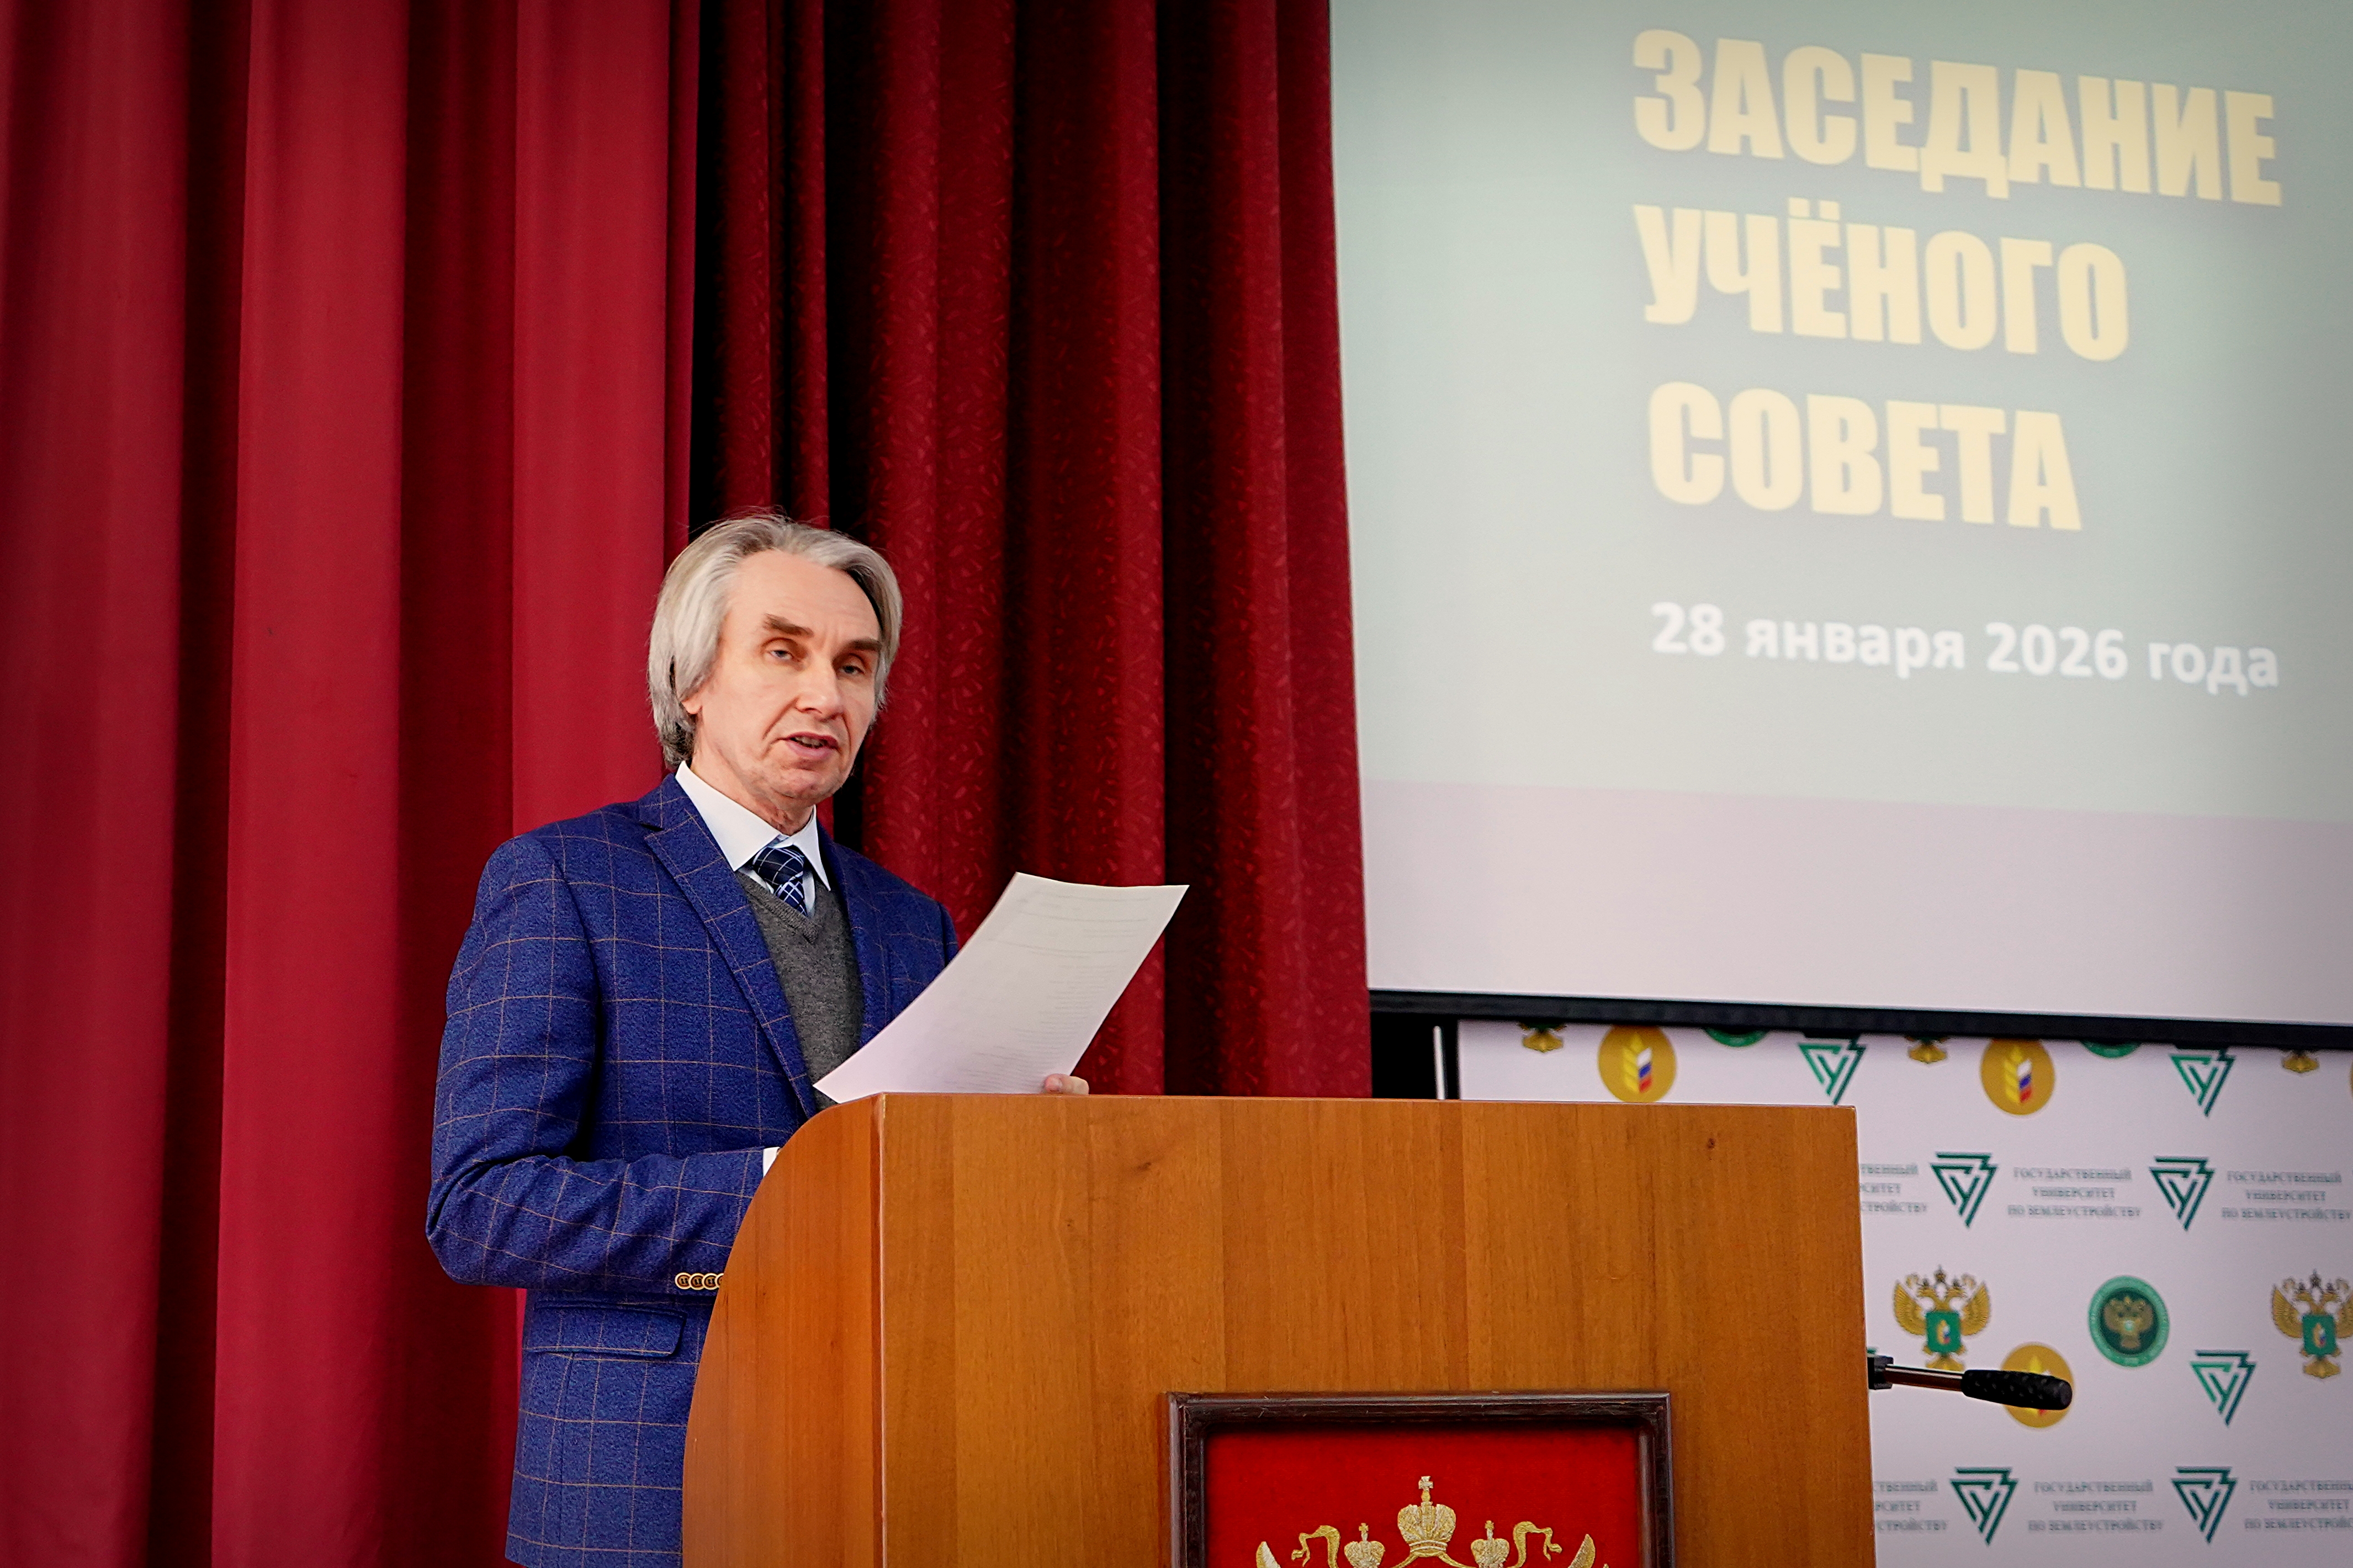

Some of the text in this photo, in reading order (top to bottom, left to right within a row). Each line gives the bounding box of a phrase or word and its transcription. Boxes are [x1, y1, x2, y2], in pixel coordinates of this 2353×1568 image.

[1632, 29, 2283, 207] ЗАСЕДАНИЕ
[1633, 196, 2129, 362] УЧЁНОГО
[1648, 381, 2082, 531] СОВЕТА
[1651, 600, 2280, 696] 28 января 2026 года
